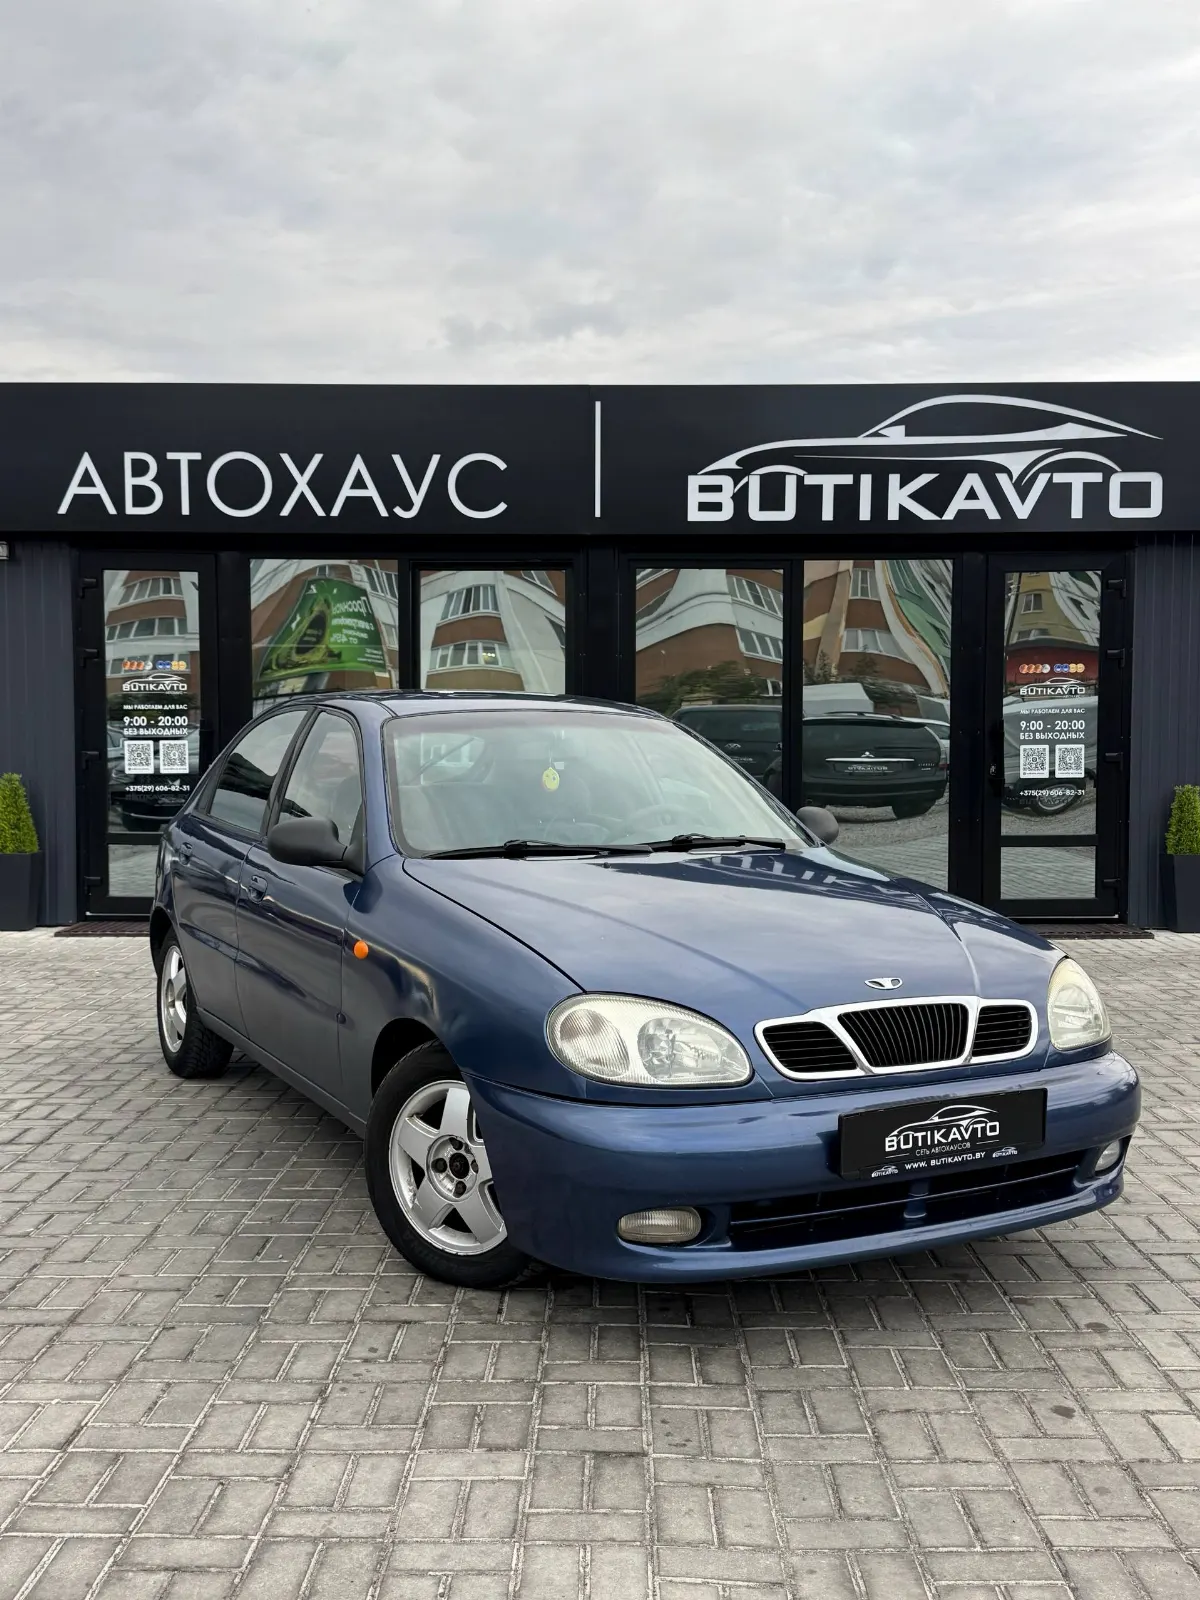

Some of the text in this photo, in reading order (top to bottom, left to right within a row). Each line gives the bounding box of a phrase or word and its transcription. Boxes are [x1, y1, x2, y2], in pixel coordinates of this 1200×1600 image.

[57, 451, 508, 519] АВТОХАУС
[687, 471, 1163, 522] BUTIKAVTO
[123, 683, 187, 691] BUTIKAVTO
[1020, 687, 1085, 695] BUTIKAVTO
[123, 716, 147, 726] 9:00
[158, 716, 188, 726] 20:00
[1020, 720, 1044, 731] 9:00
[1054, 720, 1086, 730] 20:00
[123, 728, 188, 736] БЕЗ ВЫХОДНЫХ
[1020, 732, 1085, 740] БЕЗ ВЫХОДНЫХ
[885, 1121, 999, 1152] BUTIKAVTO
[916, 1142, 971, 1156] СЕТЬ АВТОХАУСОВ
[905, 1151, 986, 1170] WWW. BUTIKAVTO.BY
